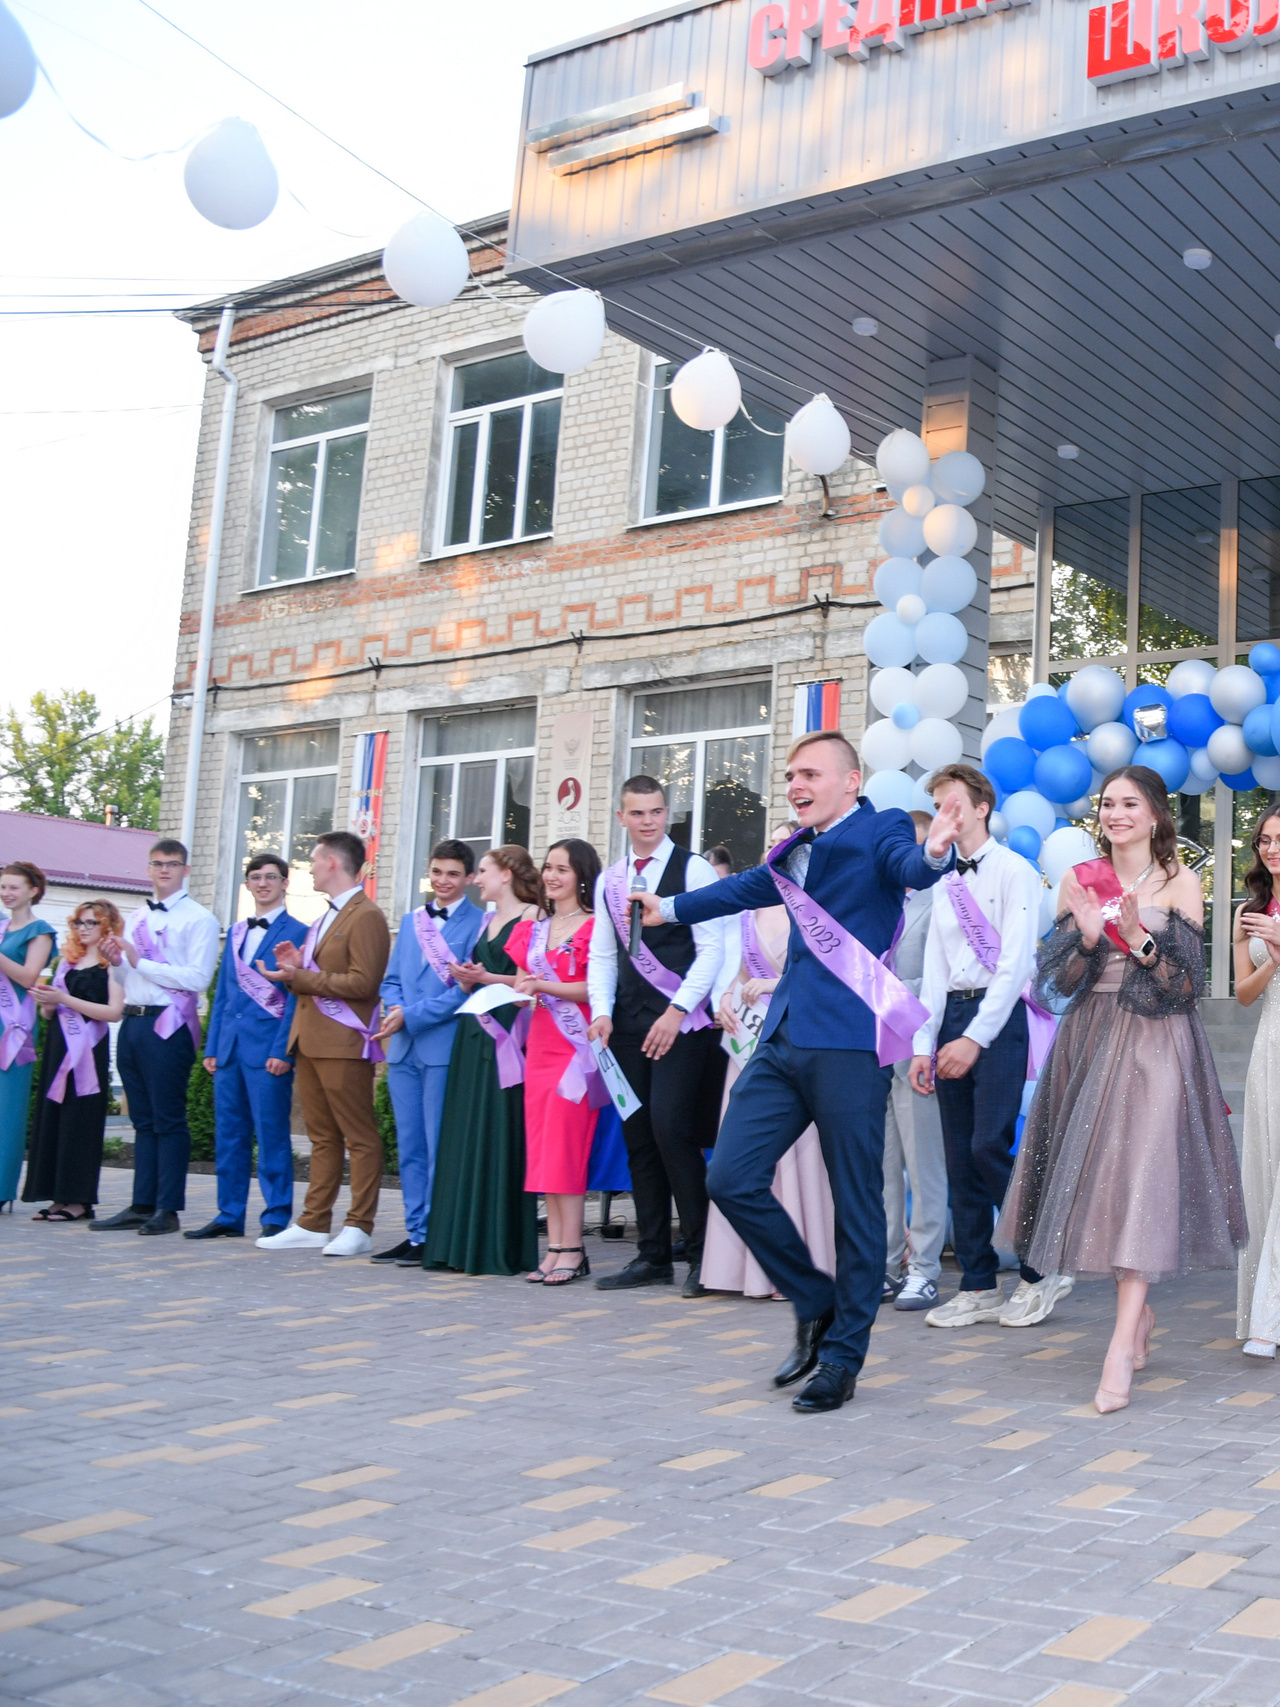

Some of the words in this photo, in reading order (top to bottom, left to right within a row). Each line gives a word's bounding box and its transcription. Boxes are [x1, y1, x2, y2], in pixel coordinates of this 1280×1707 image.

[748, 0, 1030, 72] СРЕД
[802, 916, 842, 954] 2023
[948, 883, 1000, 960] Выпускник
[638, 953, 657, 974] 023
[65, 1013, 81, 1036] 2023
[557, 1007, 583, 1035] 2023
[733, 1001, 765, 1037] ЛЯ
